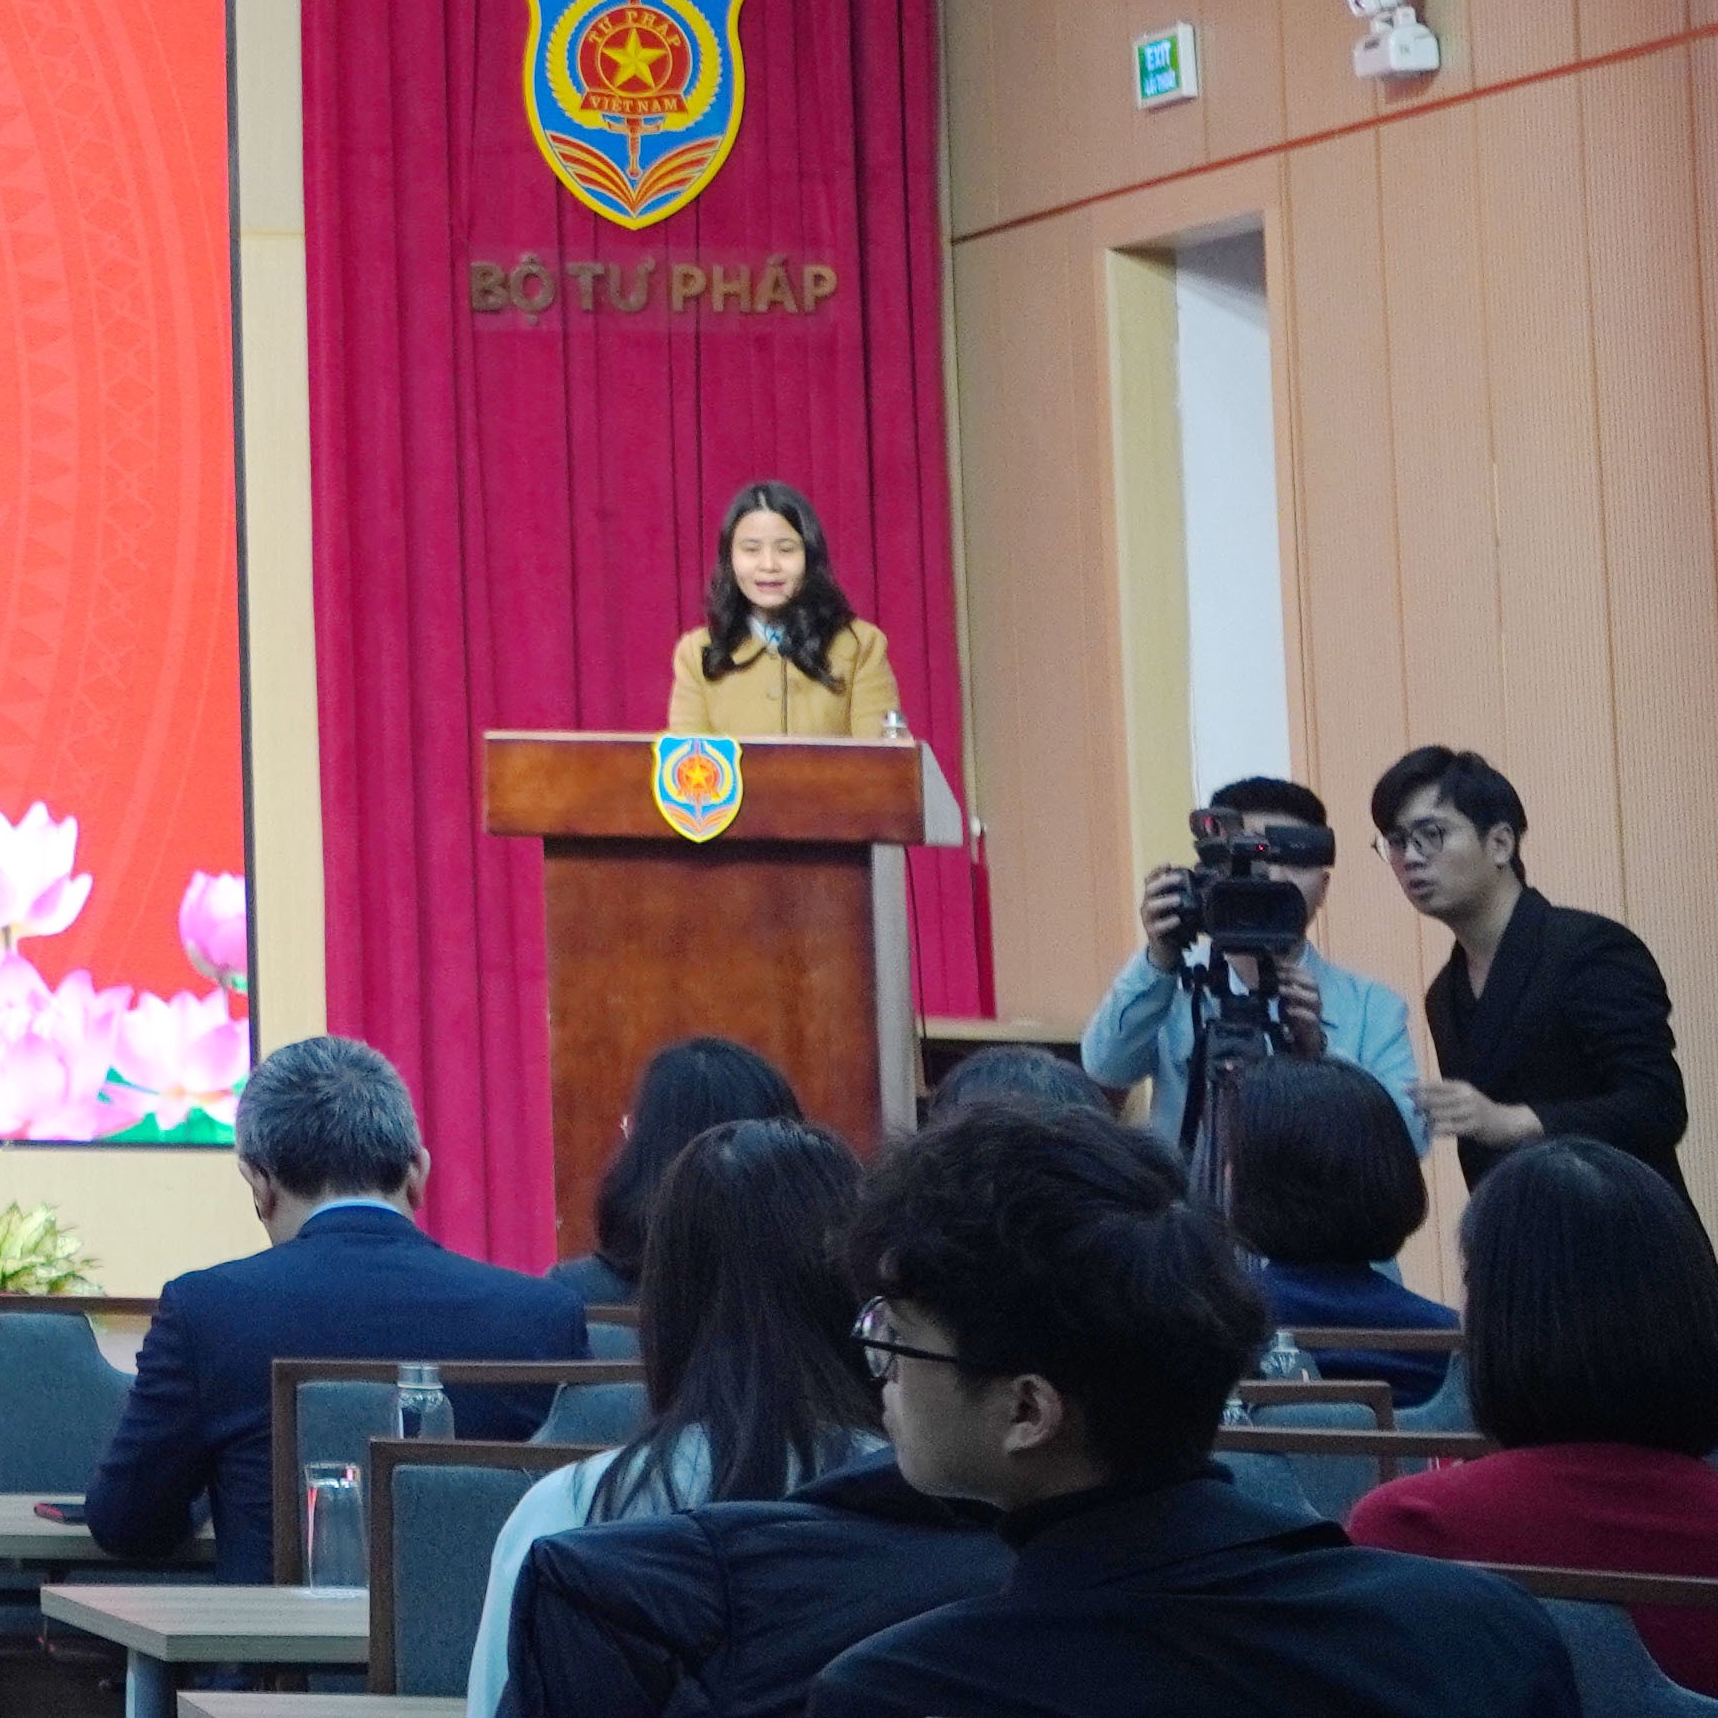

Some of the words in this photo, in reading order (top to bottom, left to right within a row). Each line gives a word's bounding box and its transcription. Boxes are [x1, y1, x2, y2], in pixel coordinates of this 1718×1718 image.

[1145, 40, 1171, 70] EXIT
[638, 97, 678, 112] NAM
[470, 252, 556, 326] BỘ
[567, 258, 656, 312] TƯ
[671, 253, 838, 313] PHÁP
